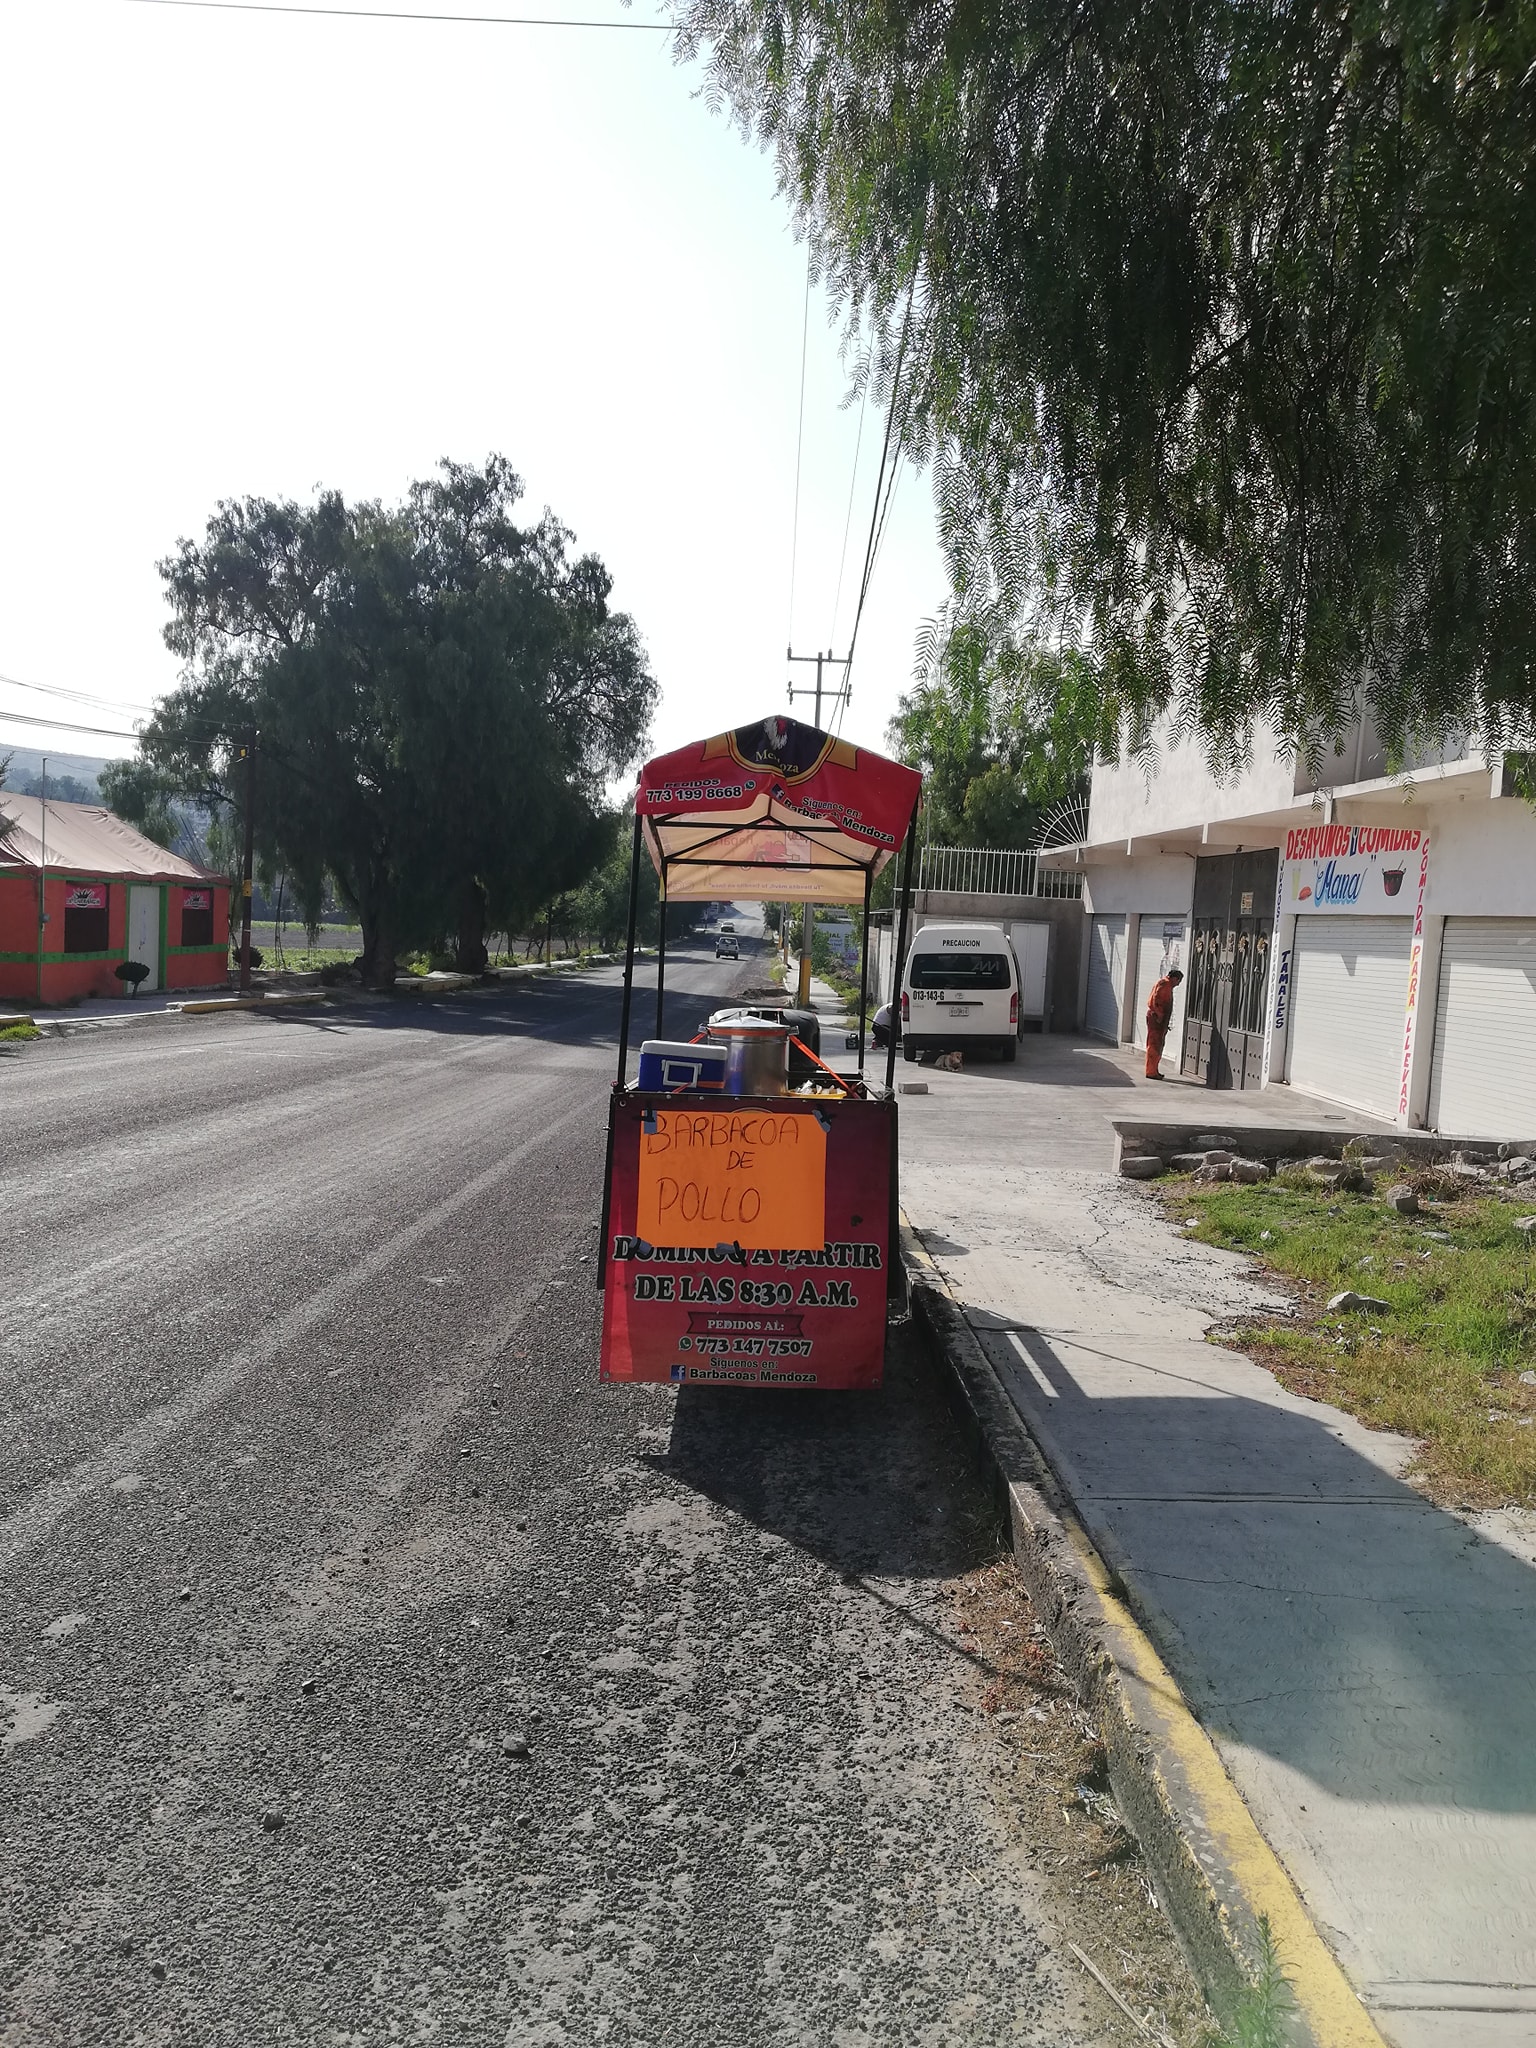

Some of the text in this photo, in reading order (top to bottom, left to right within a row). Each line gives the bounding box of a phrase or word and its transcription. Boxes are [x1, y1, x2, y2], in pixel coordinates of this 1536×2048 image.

[755, 749, 799, 773] Meoza
[646, 786, 743, 803] 773 199 8668
[842, 816, 895, 844] Mendoza
[1286, 824, 1351, 861] DESAYUNOS
[1349, 826, 1360, 857] Y
[942, 939, 981, 947] PRECAUCION
[1398, 837, 1430, 1115] COMIDA PARA LLEVAR
[912, 990, 945, 1001] 013-143-G
[1275, 950, 1291, 1029] TAMALES
[646, 1113, 800, 1155] BARBACOA
[726, 1150, 755, 1171] DE
[656, 1176, 761, 1225] POLLO
[751, 1247, 774, 1266] A
[634, 1275, 859, 1308] DE LAS 8:30 A.M.
[707, 1319, 785, 1332] PEDIDOS AL:
[696, 1336, 813, 1357] 773 147 7507
[761, 1358, 778, 1370] en:
[689, 1368, 817, 1384] Barbacoas Mendoza
